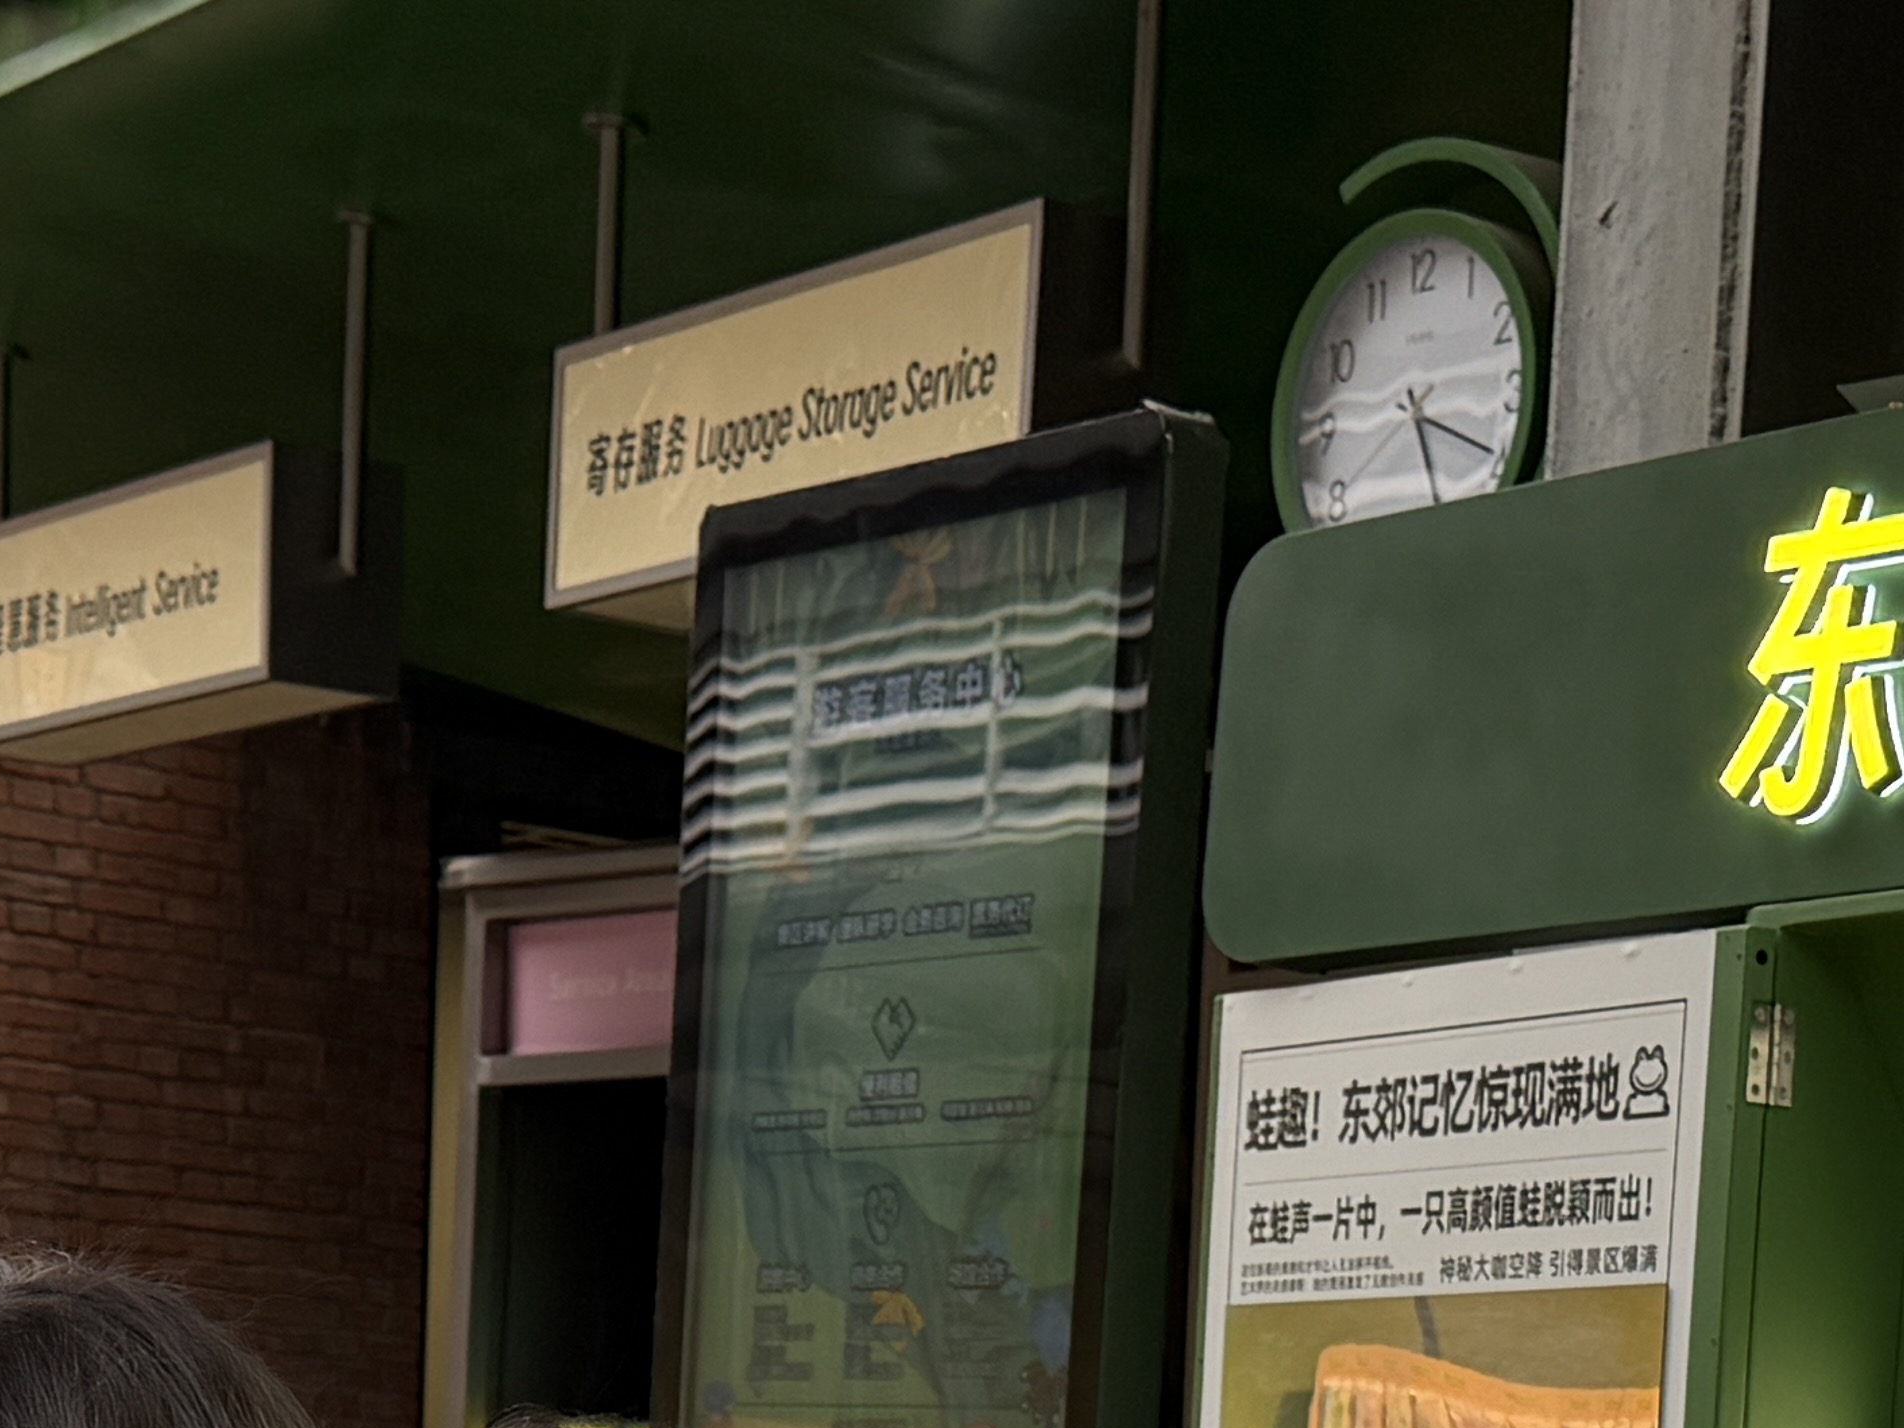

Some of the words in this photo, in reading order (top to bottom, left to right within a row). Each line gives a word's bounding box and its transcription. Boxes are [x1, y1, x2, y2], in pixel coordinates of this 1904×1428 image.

[1411, 249, 1436, 294] 12
[1467, 256, 1474, 298] 1
[1367, 280, 1386, 323] 11
[1493, 301, 1512, 347] 2
[1330, 340, 1354, 383] 10
[587, 413, 688, 498] 寄存服务
[695, 404, 795, 471] Luggage
[798, 380, 897, 441] Storage
[902, 346, 997, 417] Service
[1327, 479, 1346, 523] 8
[64, 577, 148, 638] Intelligent
[151, 561, 220, 617] Service
